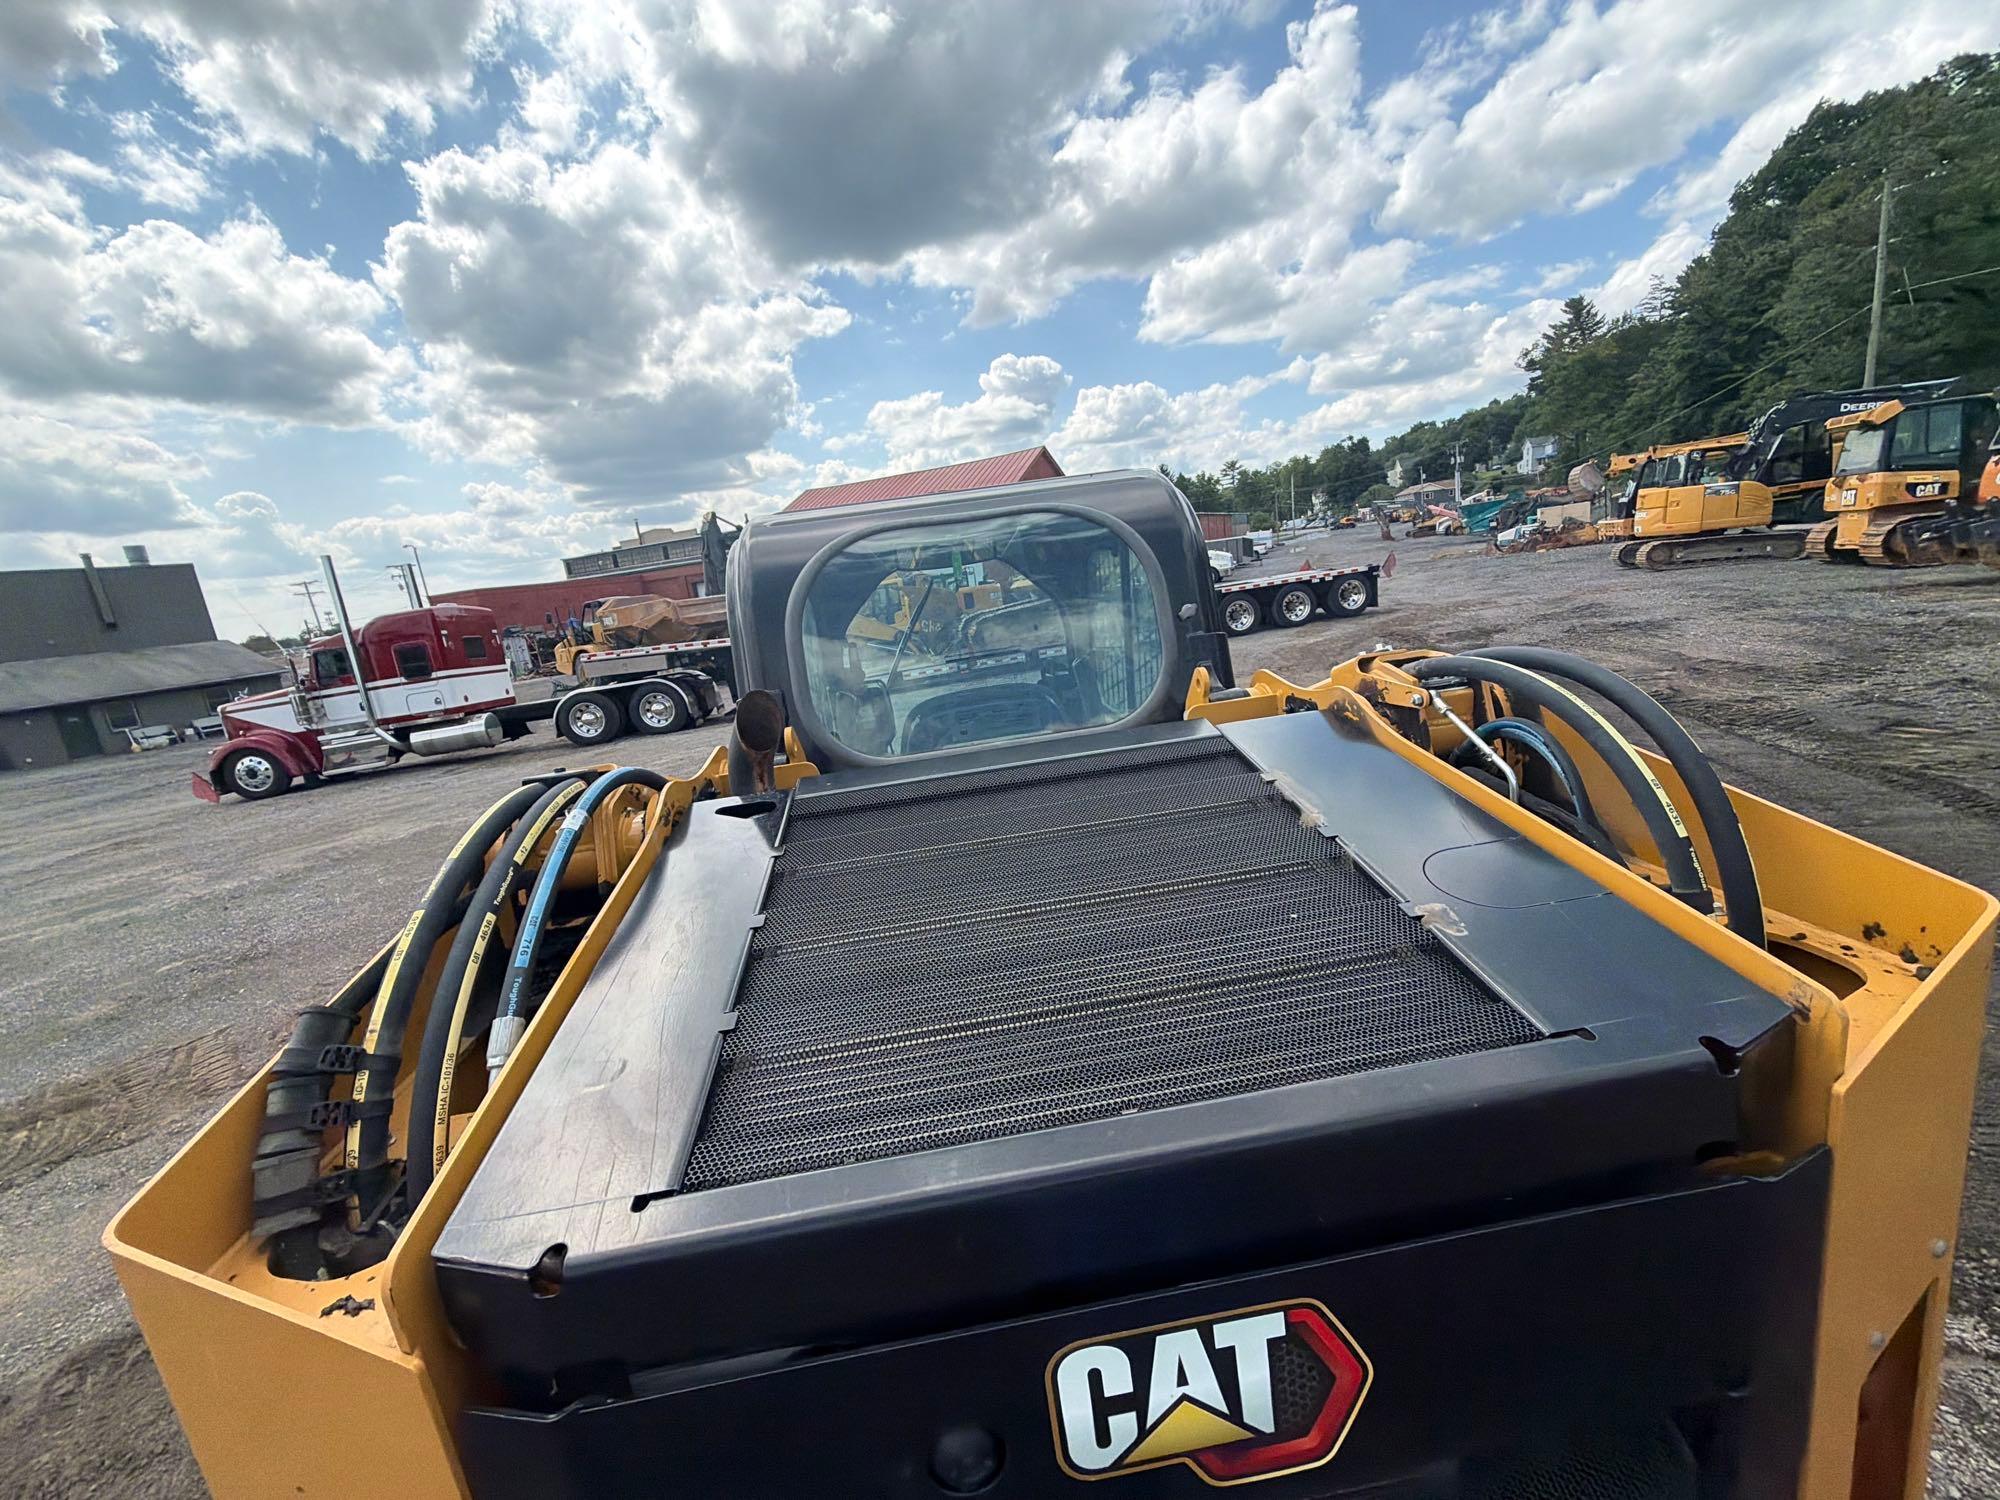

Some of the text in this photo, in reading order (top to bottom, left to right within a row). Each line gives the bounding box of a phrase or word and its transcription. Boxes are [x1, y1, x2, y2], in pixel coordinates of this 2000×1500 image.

[1841, 489, 1857, 506] CAT
[1915, 483, 1942, 497] CAT
[472, 919, 493, 965] CAT 4636
[519, 938, 533, 956] 716
[507, 976, 523, 1017] ToughGu
[355, 1071, 366, 1096] IC-10
[437, 1053, 455, 1125] MSHA IC-101/36
[1057, 1311, 1286, 1470] CAT
